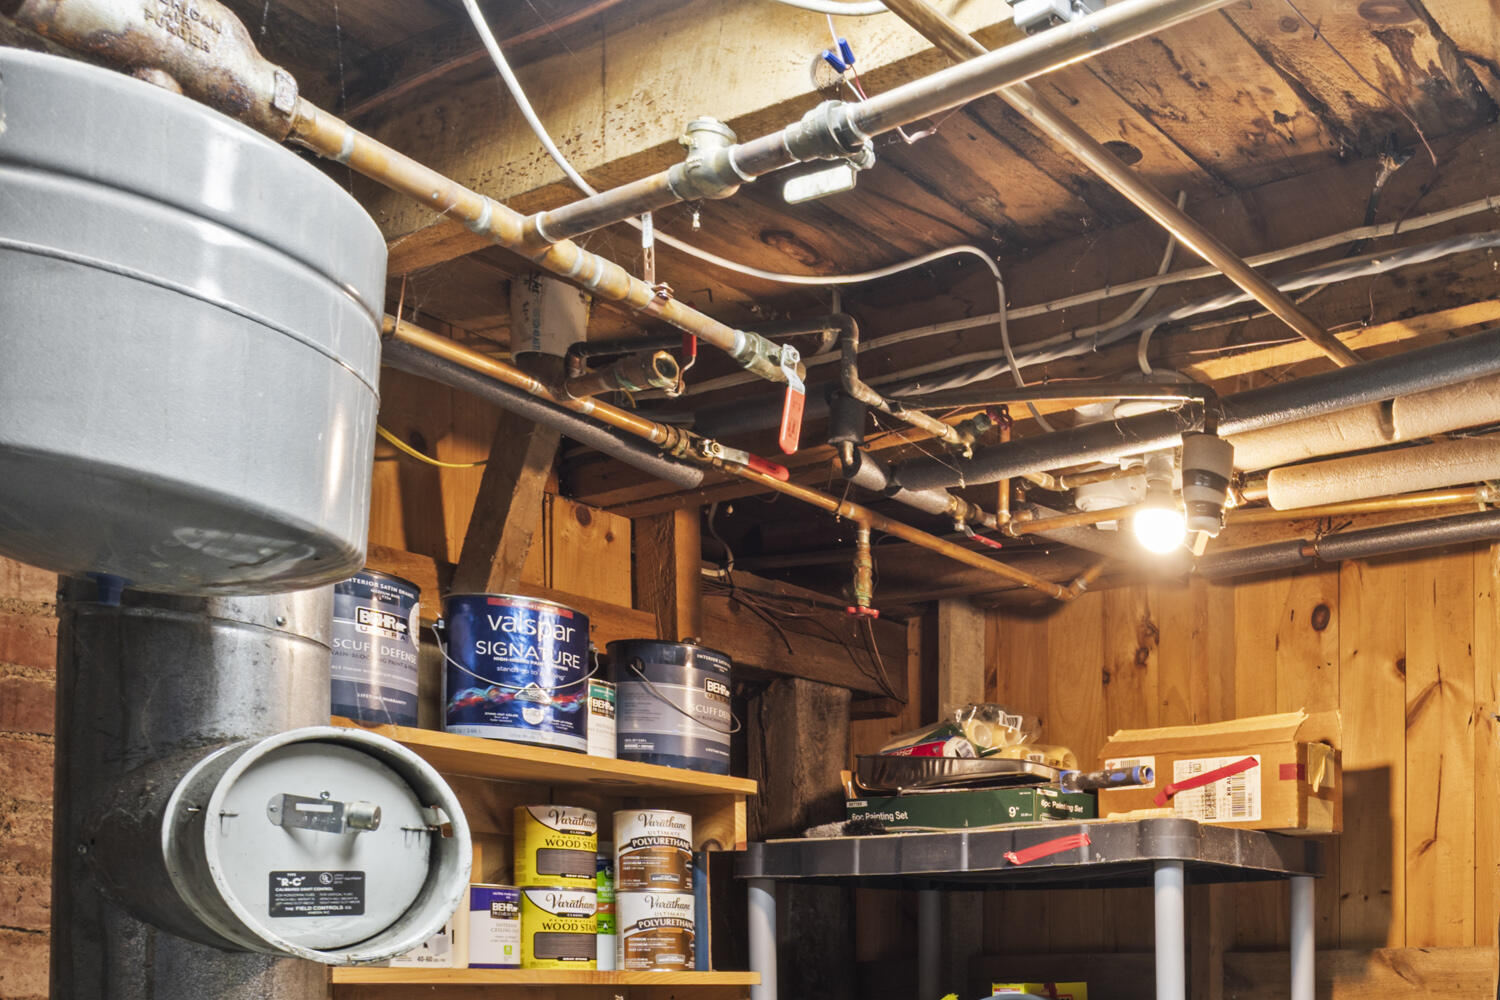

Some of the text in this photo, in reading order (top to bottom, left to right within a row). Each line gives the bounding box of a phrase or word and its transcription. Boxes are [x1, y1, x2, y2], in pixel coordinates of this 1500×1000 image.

[360, 610, 397, 629] BEHR
[360, 626, 406, 641] UTRA
[487, 611, 576, 643] valspar
[475, 640, 581, 670] SIGNATURE
[706, 679, 726, 696] BEHR
[592, 697, 610, 711] BEHR
[1074, 805, 1084, 813] Set
[638, 813, 687, 831] Varathane
[865, 811, 909, 822] Painting Set
[545, 838, 581, 849] WOOD
[631, 836, 691, 850] POLYURETHANE
[492, 902, 513, 912] BEHR
[645, 895, 691, 911] Varathane
[542, 922, 579, 932] WOOD
[638, 917, 694, 930] POLYURETHANE
